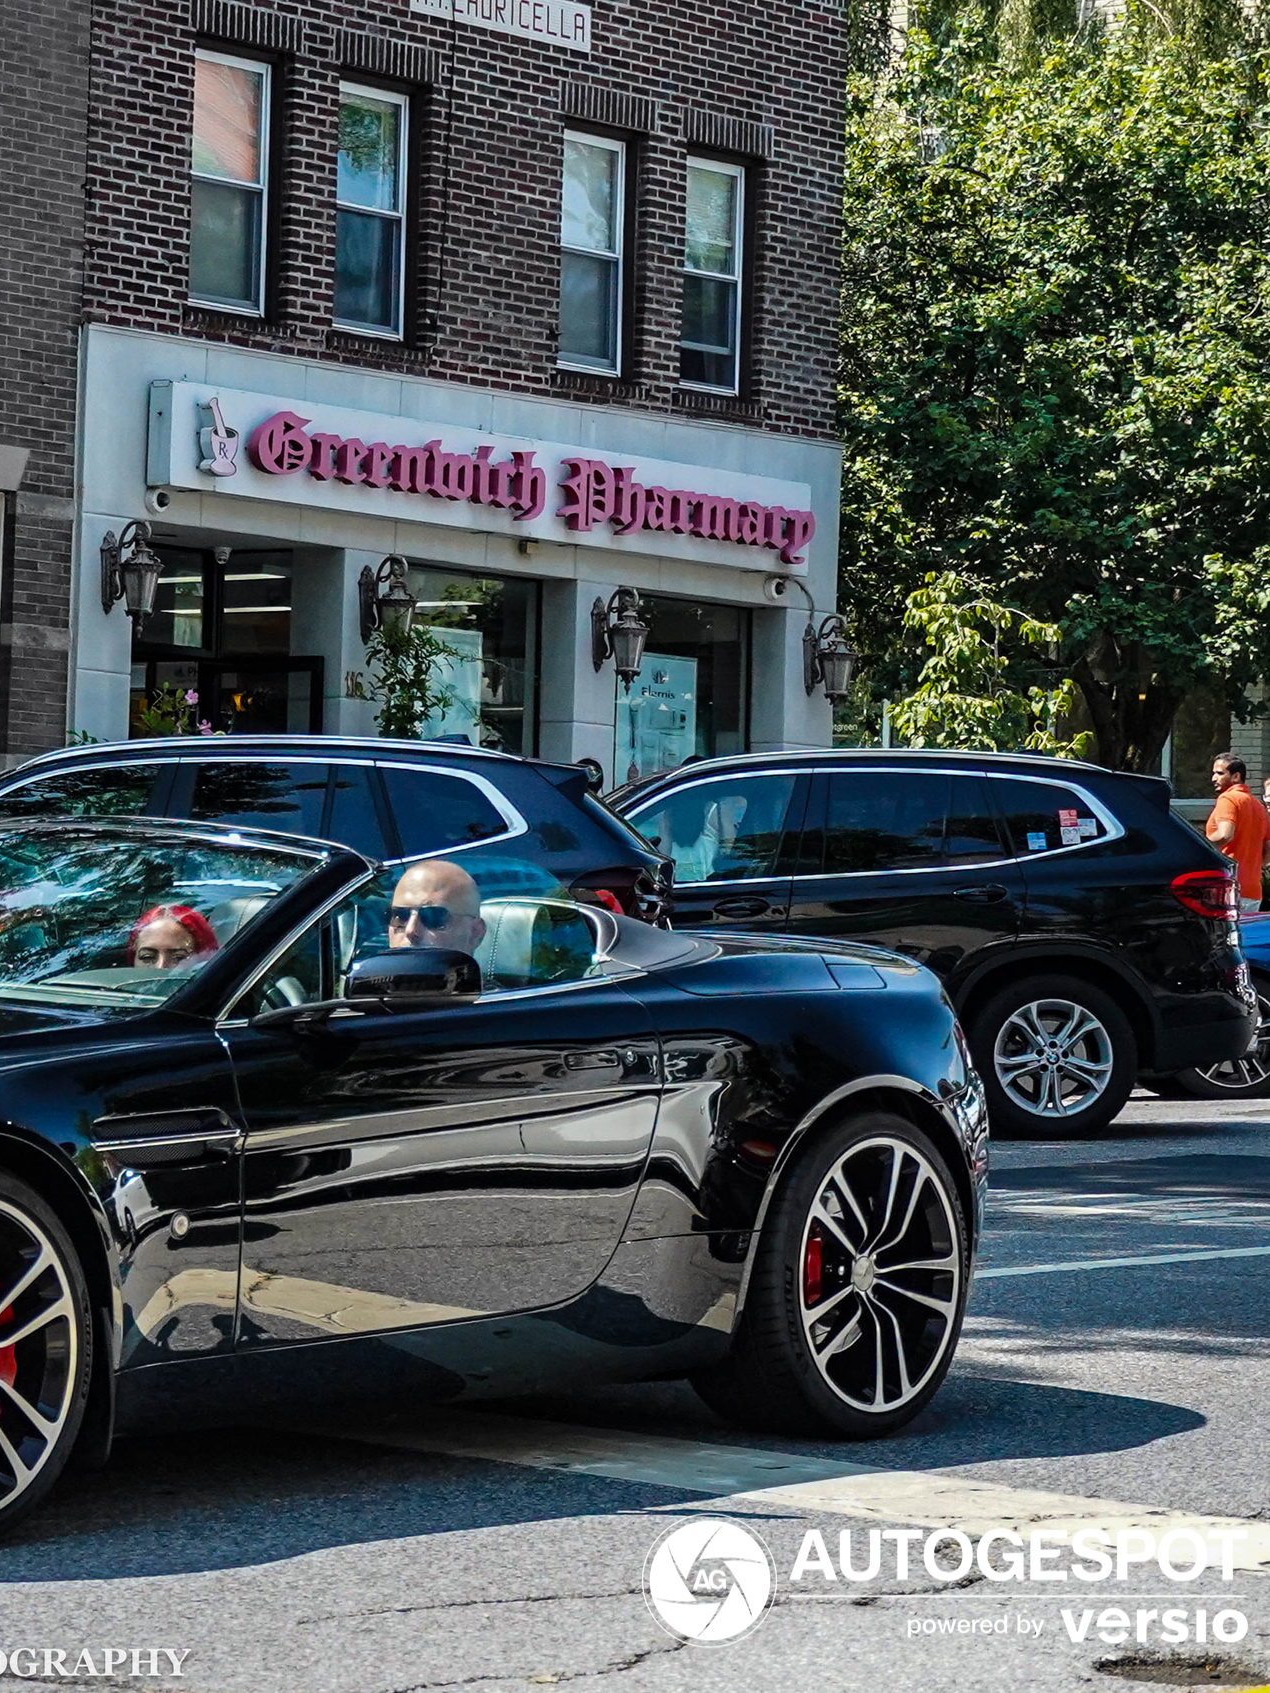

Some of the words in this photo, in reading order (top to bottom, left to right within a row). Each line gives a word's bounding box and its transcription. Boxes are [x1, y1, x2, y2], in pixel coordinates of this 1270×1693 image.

[247, 410, 545, 521] Greenwich
[556, 457, 815, 565] Pharmacy
[344, 671, 364, 697] 116
